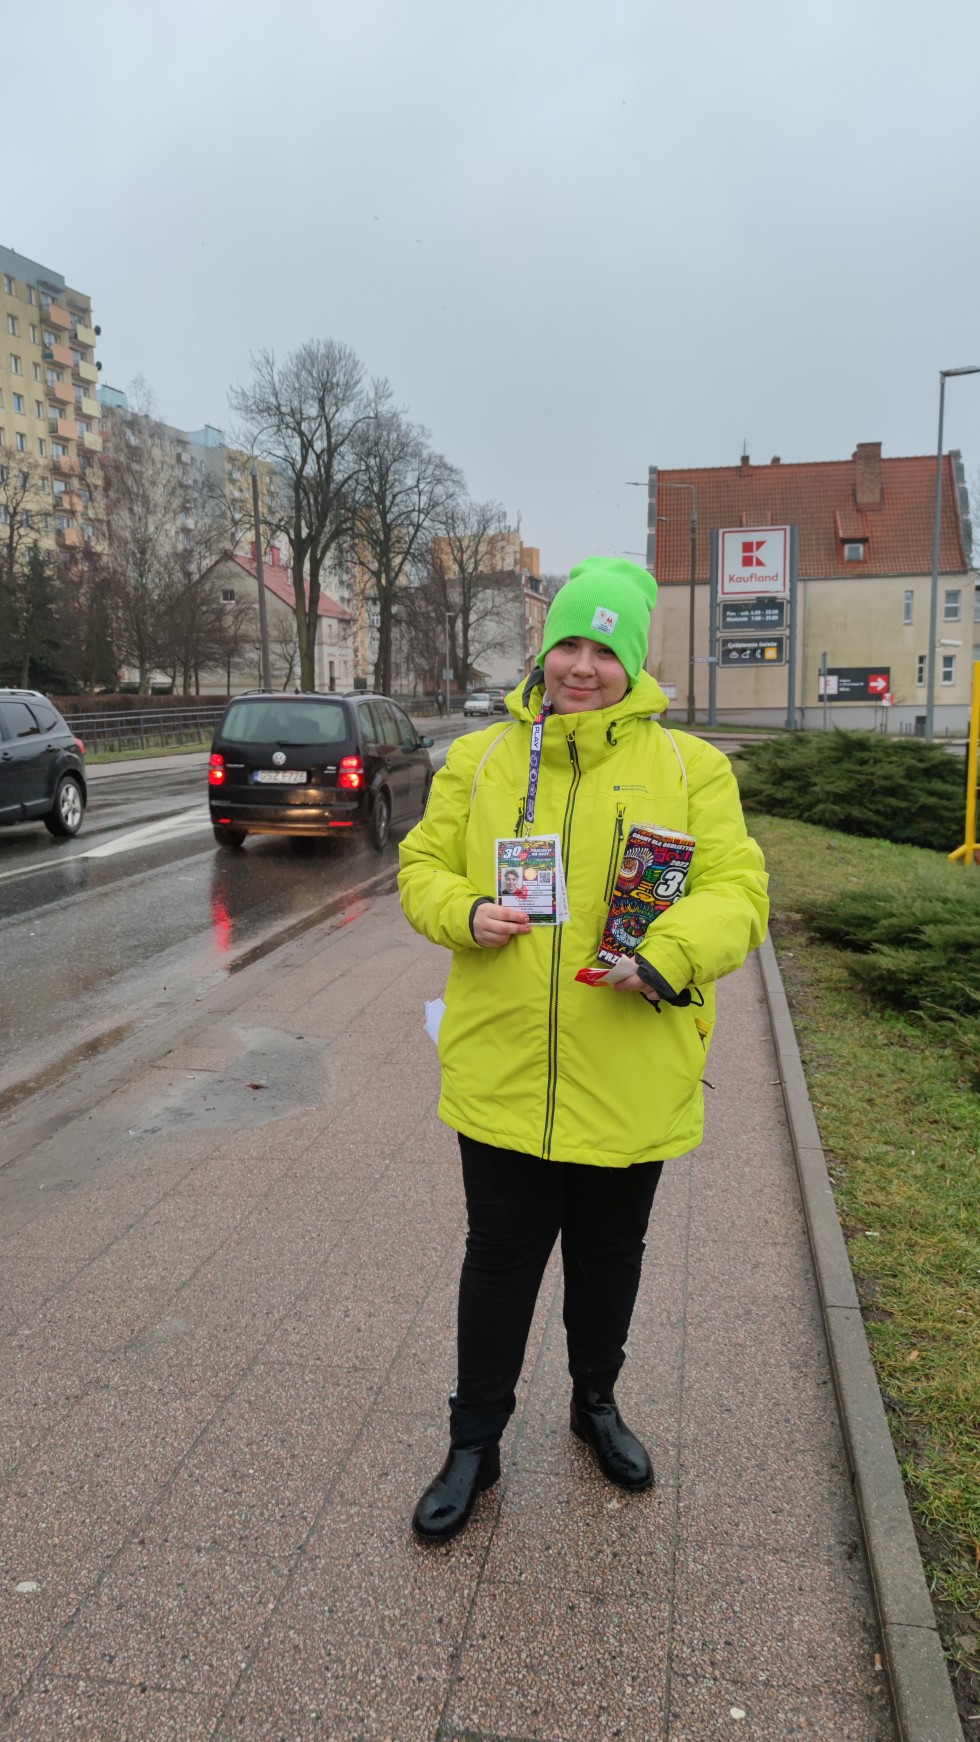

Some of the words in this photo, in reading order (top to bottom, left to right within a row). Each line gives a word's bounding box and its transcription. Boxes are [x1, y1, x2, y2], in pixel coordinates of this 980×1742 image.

[729, 572, 778, 584] Kaufland
[633, 832, 652, 843] GRAMY
[651, 839, 663, 847] DLA
[503, 846, 521, 858] 30
[670, 860, 689, 868] 2022
